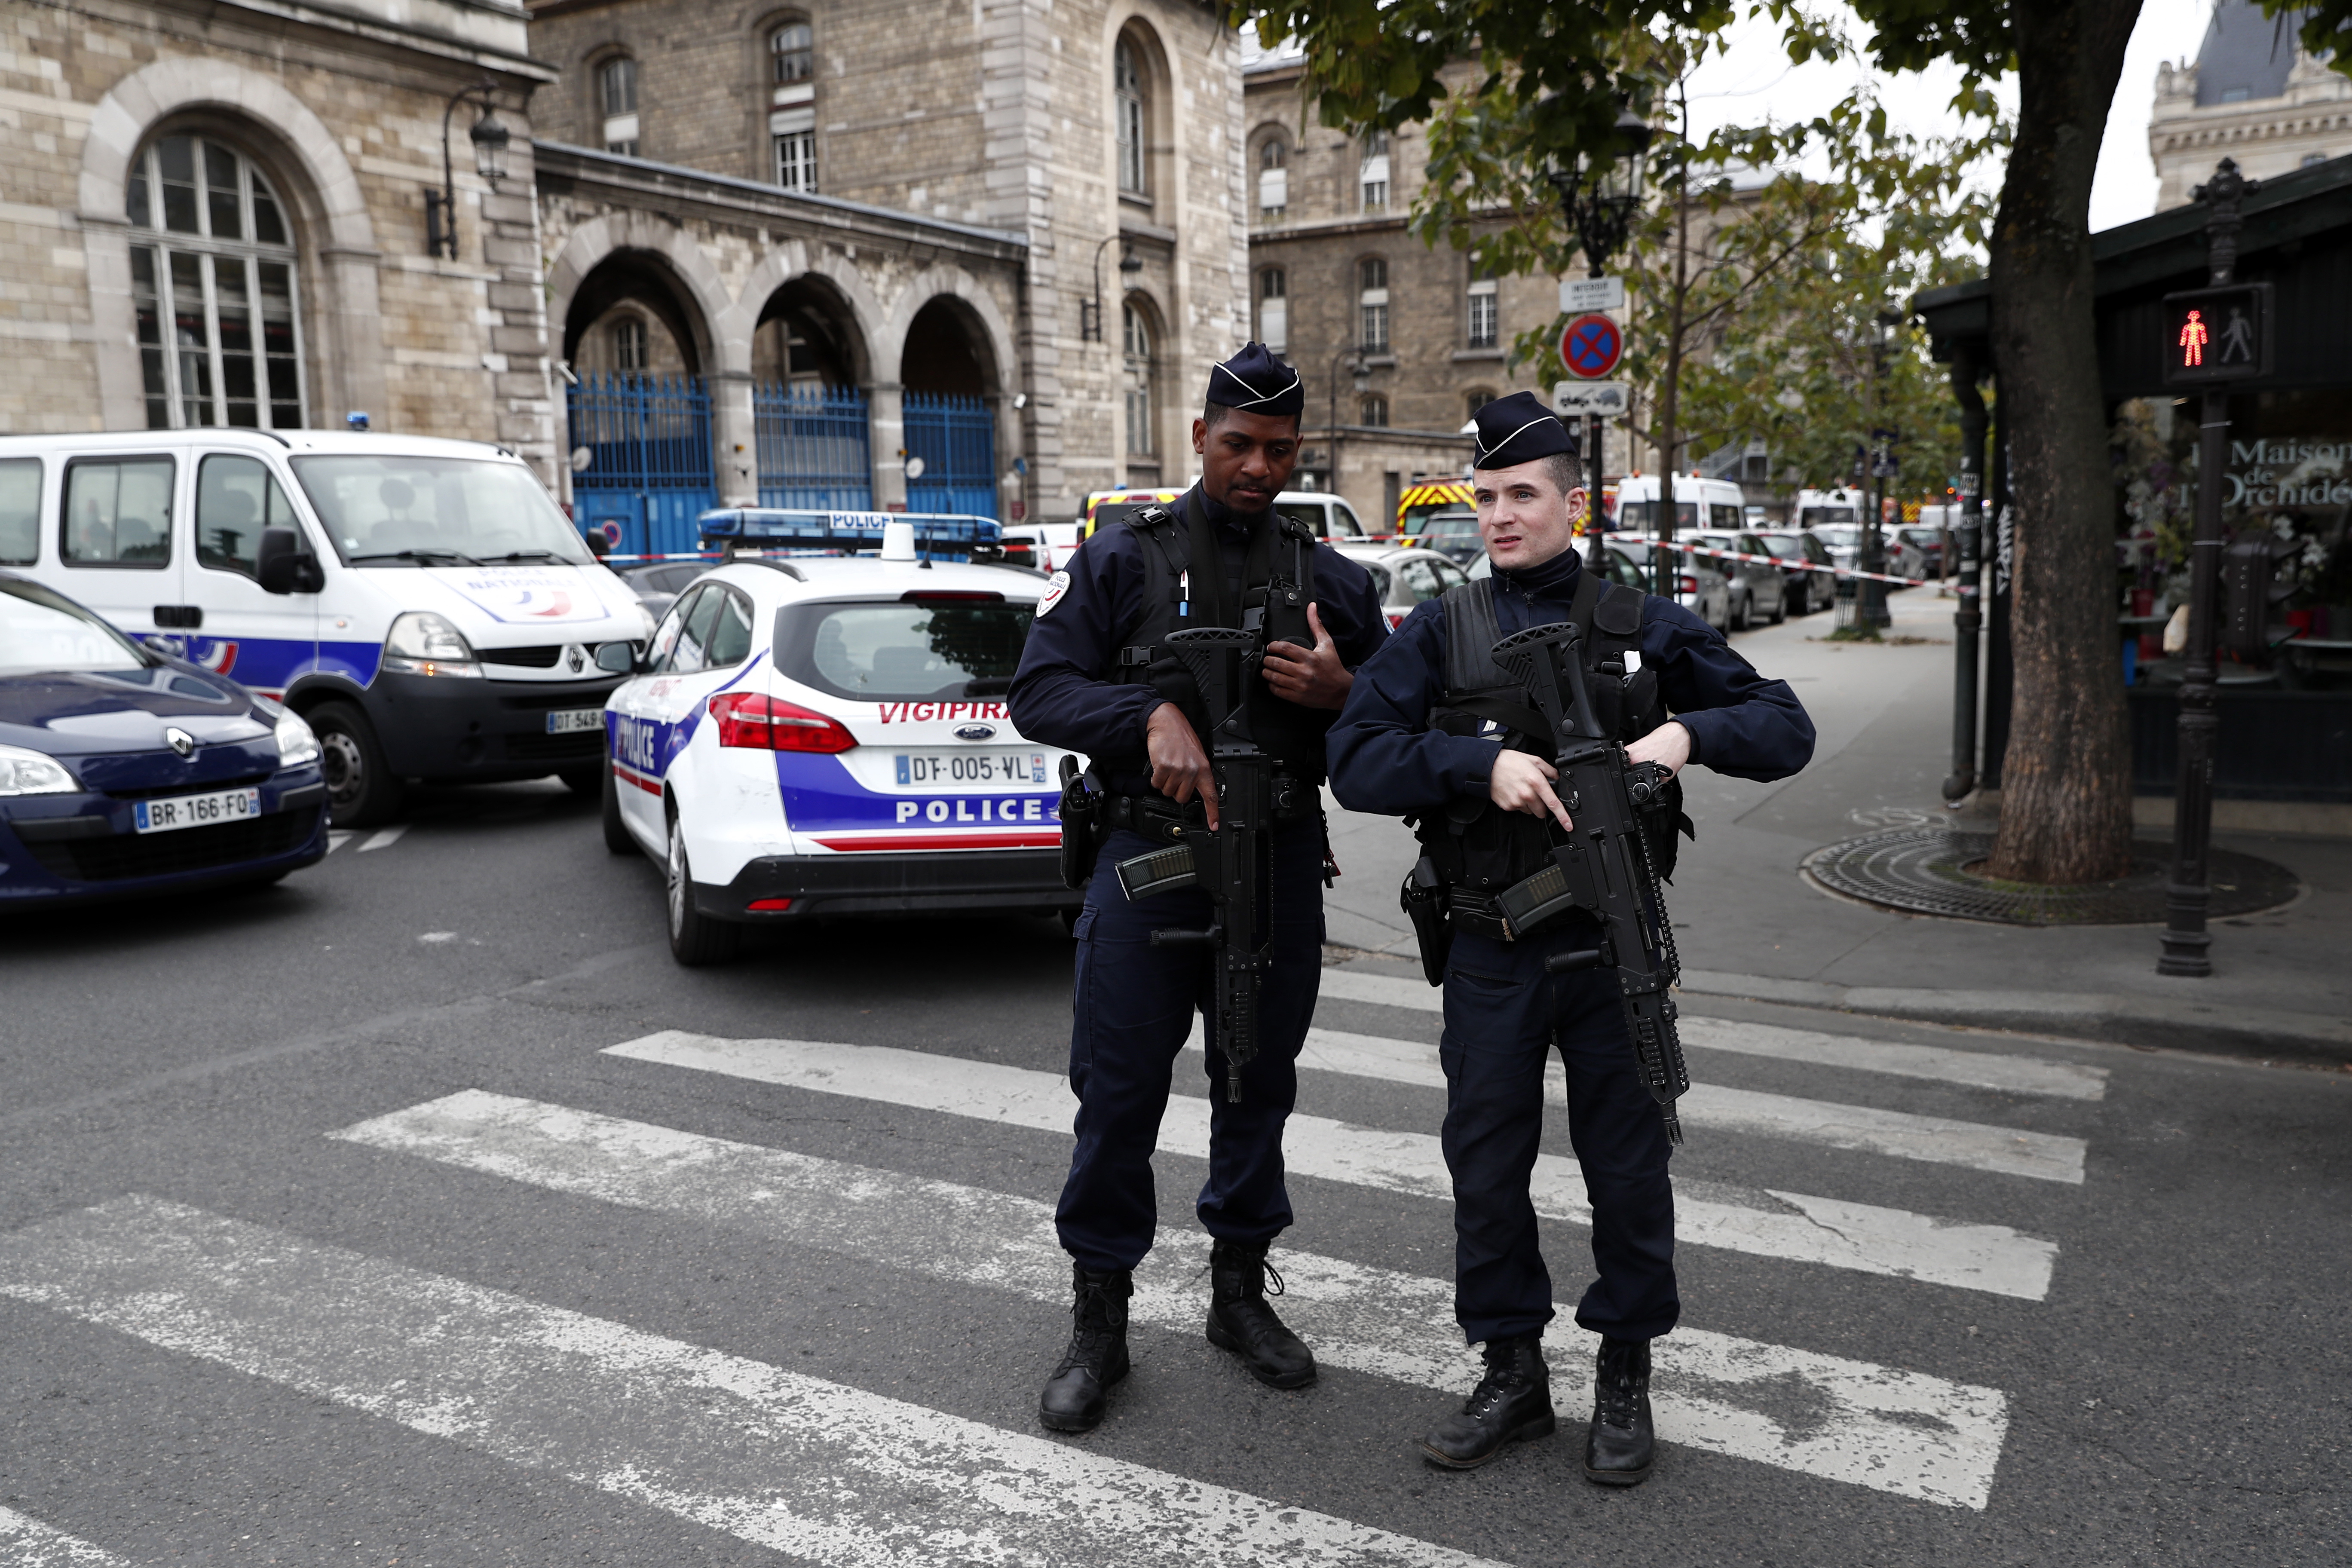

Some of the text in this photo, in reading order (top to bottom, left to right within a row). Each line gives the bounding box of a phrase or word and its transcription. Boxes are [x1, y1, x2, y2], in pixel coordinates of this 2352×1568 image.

[2243, 466, 2277, 485] de
[833, 514, 889, 527] POLICE
[1049, 581, 1066, 589] NATIONALE
[913, 756, 1029, 781] DT-005-VL
[896, 799, 1042, 823] POLICE
